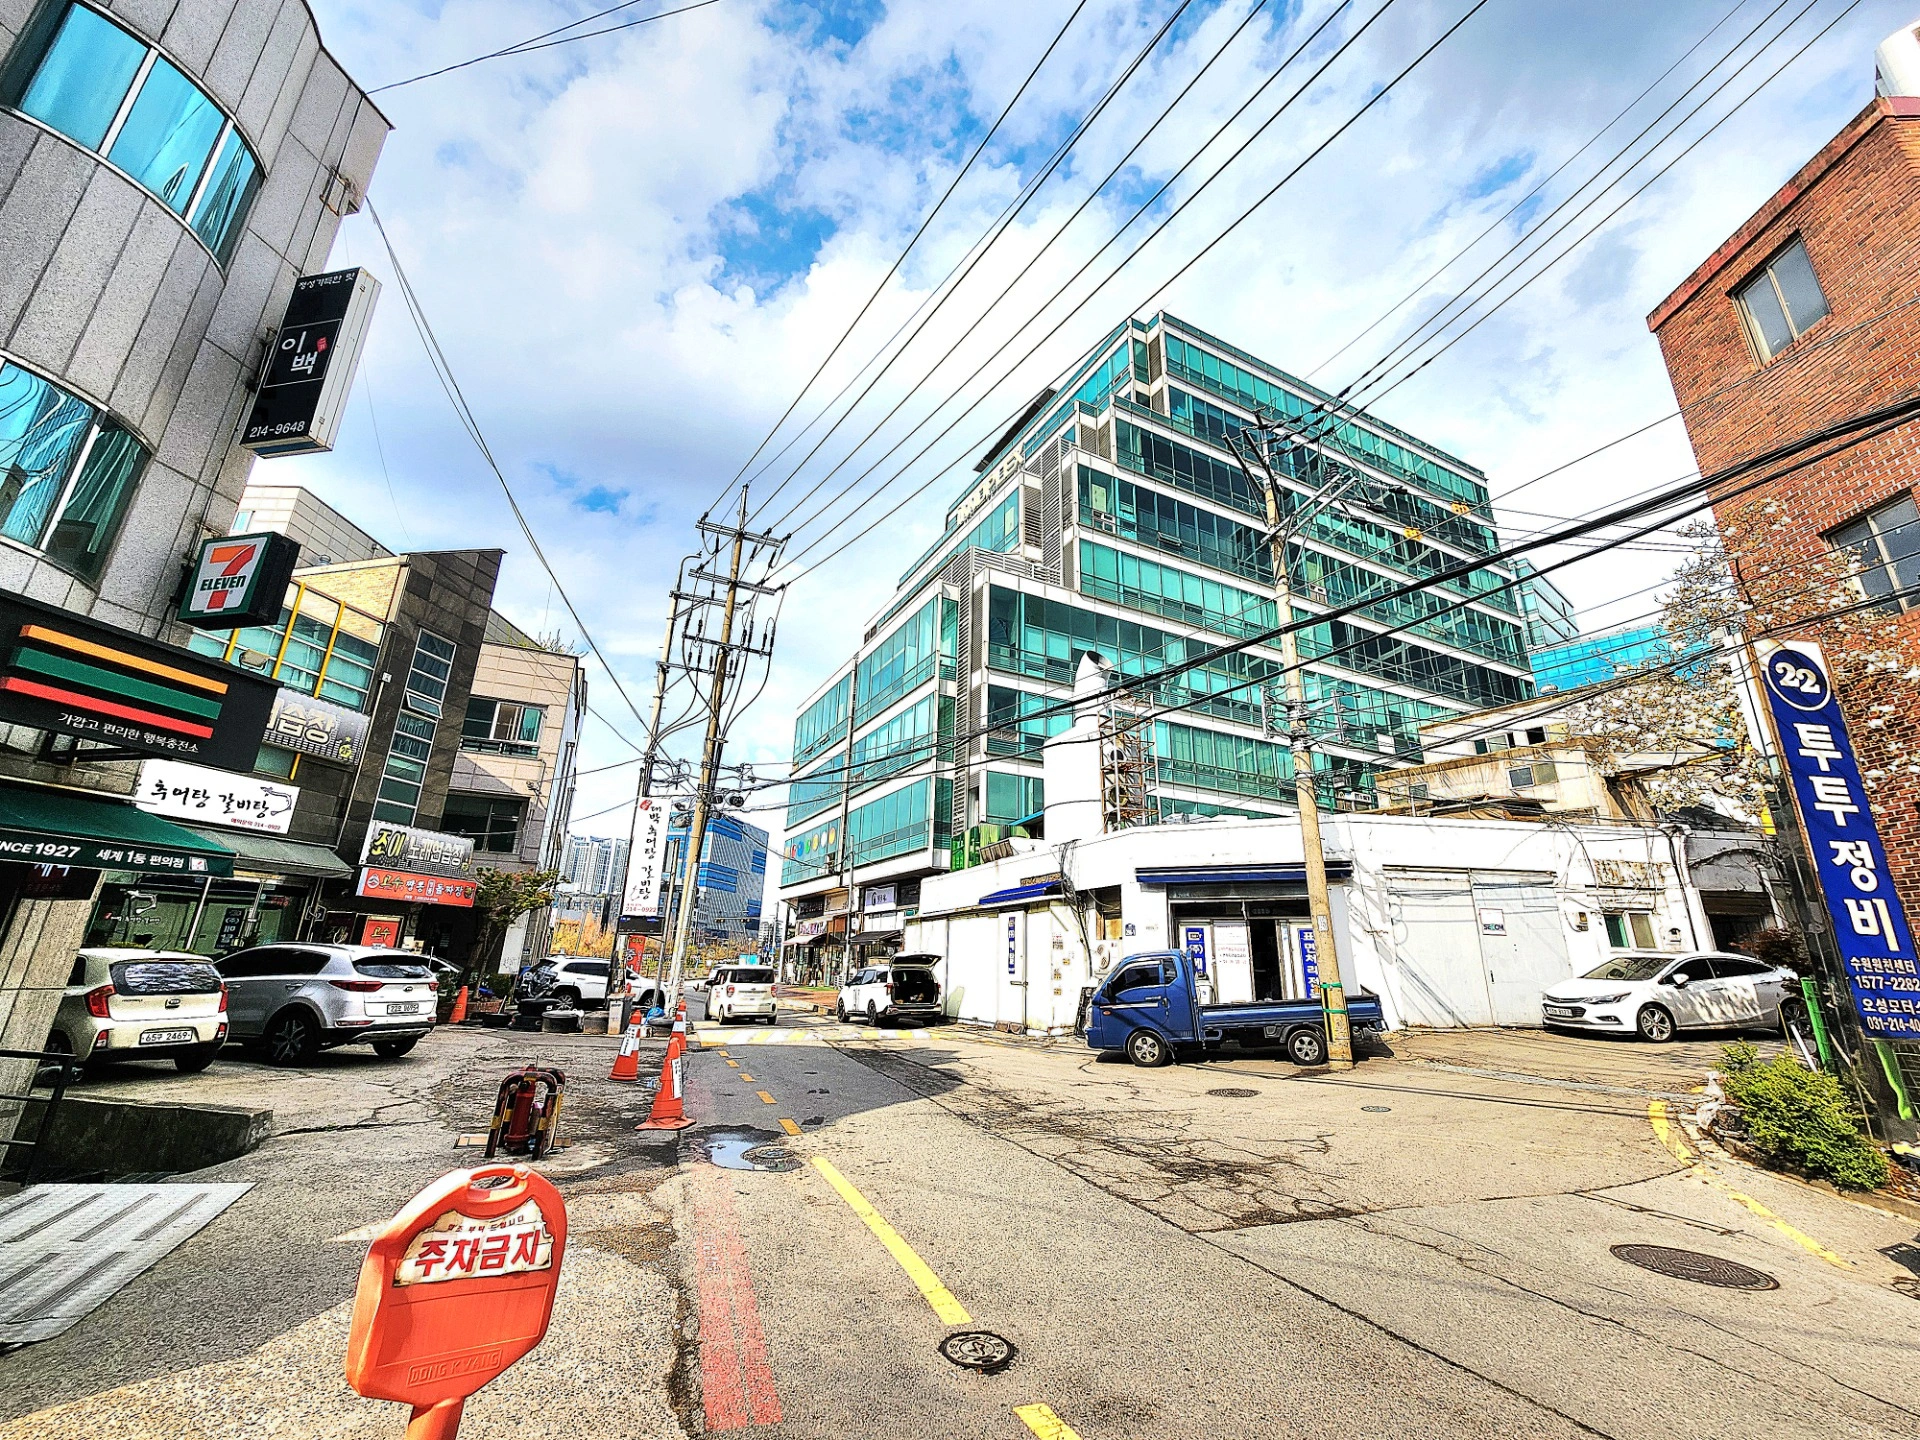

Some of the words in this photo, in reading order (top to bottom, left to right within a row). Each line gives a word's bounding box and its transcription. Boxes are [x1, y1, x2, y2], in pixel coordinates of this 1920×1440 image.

[249, 420, 306, 438] 214-9648
[1775, 661, 1821, 694] 22
[57, 712, 99, 731] 가깝고
[102, 723, 140, 741] 편리한
[143, 732, 199, 753] 행복충전소
[150, 779, 211, 809] 추어탕
[218, 793, 270, 818] 갈비탕
[0, 840, 34, 854] NCE
[35, 842, 82, 858] 1927
[370, 830, 406, 857] 조이
[407, 836, 465, 866] 노래연습장
[644, 825, 657, 860] 추어탕
[1793, 722, 1860, 828] 투투
[1829, 839, 1901, 952] 정비
[96, 849, 124, 862] 세계
[127, 850, 147, 864] 1등
[149, 854, 185, 868] 편의점
[638, 865, 655, 900] 갈비탕
[1850, 956, 1917, 975] 수원원천센터
[1855, 975, 1920, 992] 1577-2282
[414, 1229, 541, 1277] 주차금지
